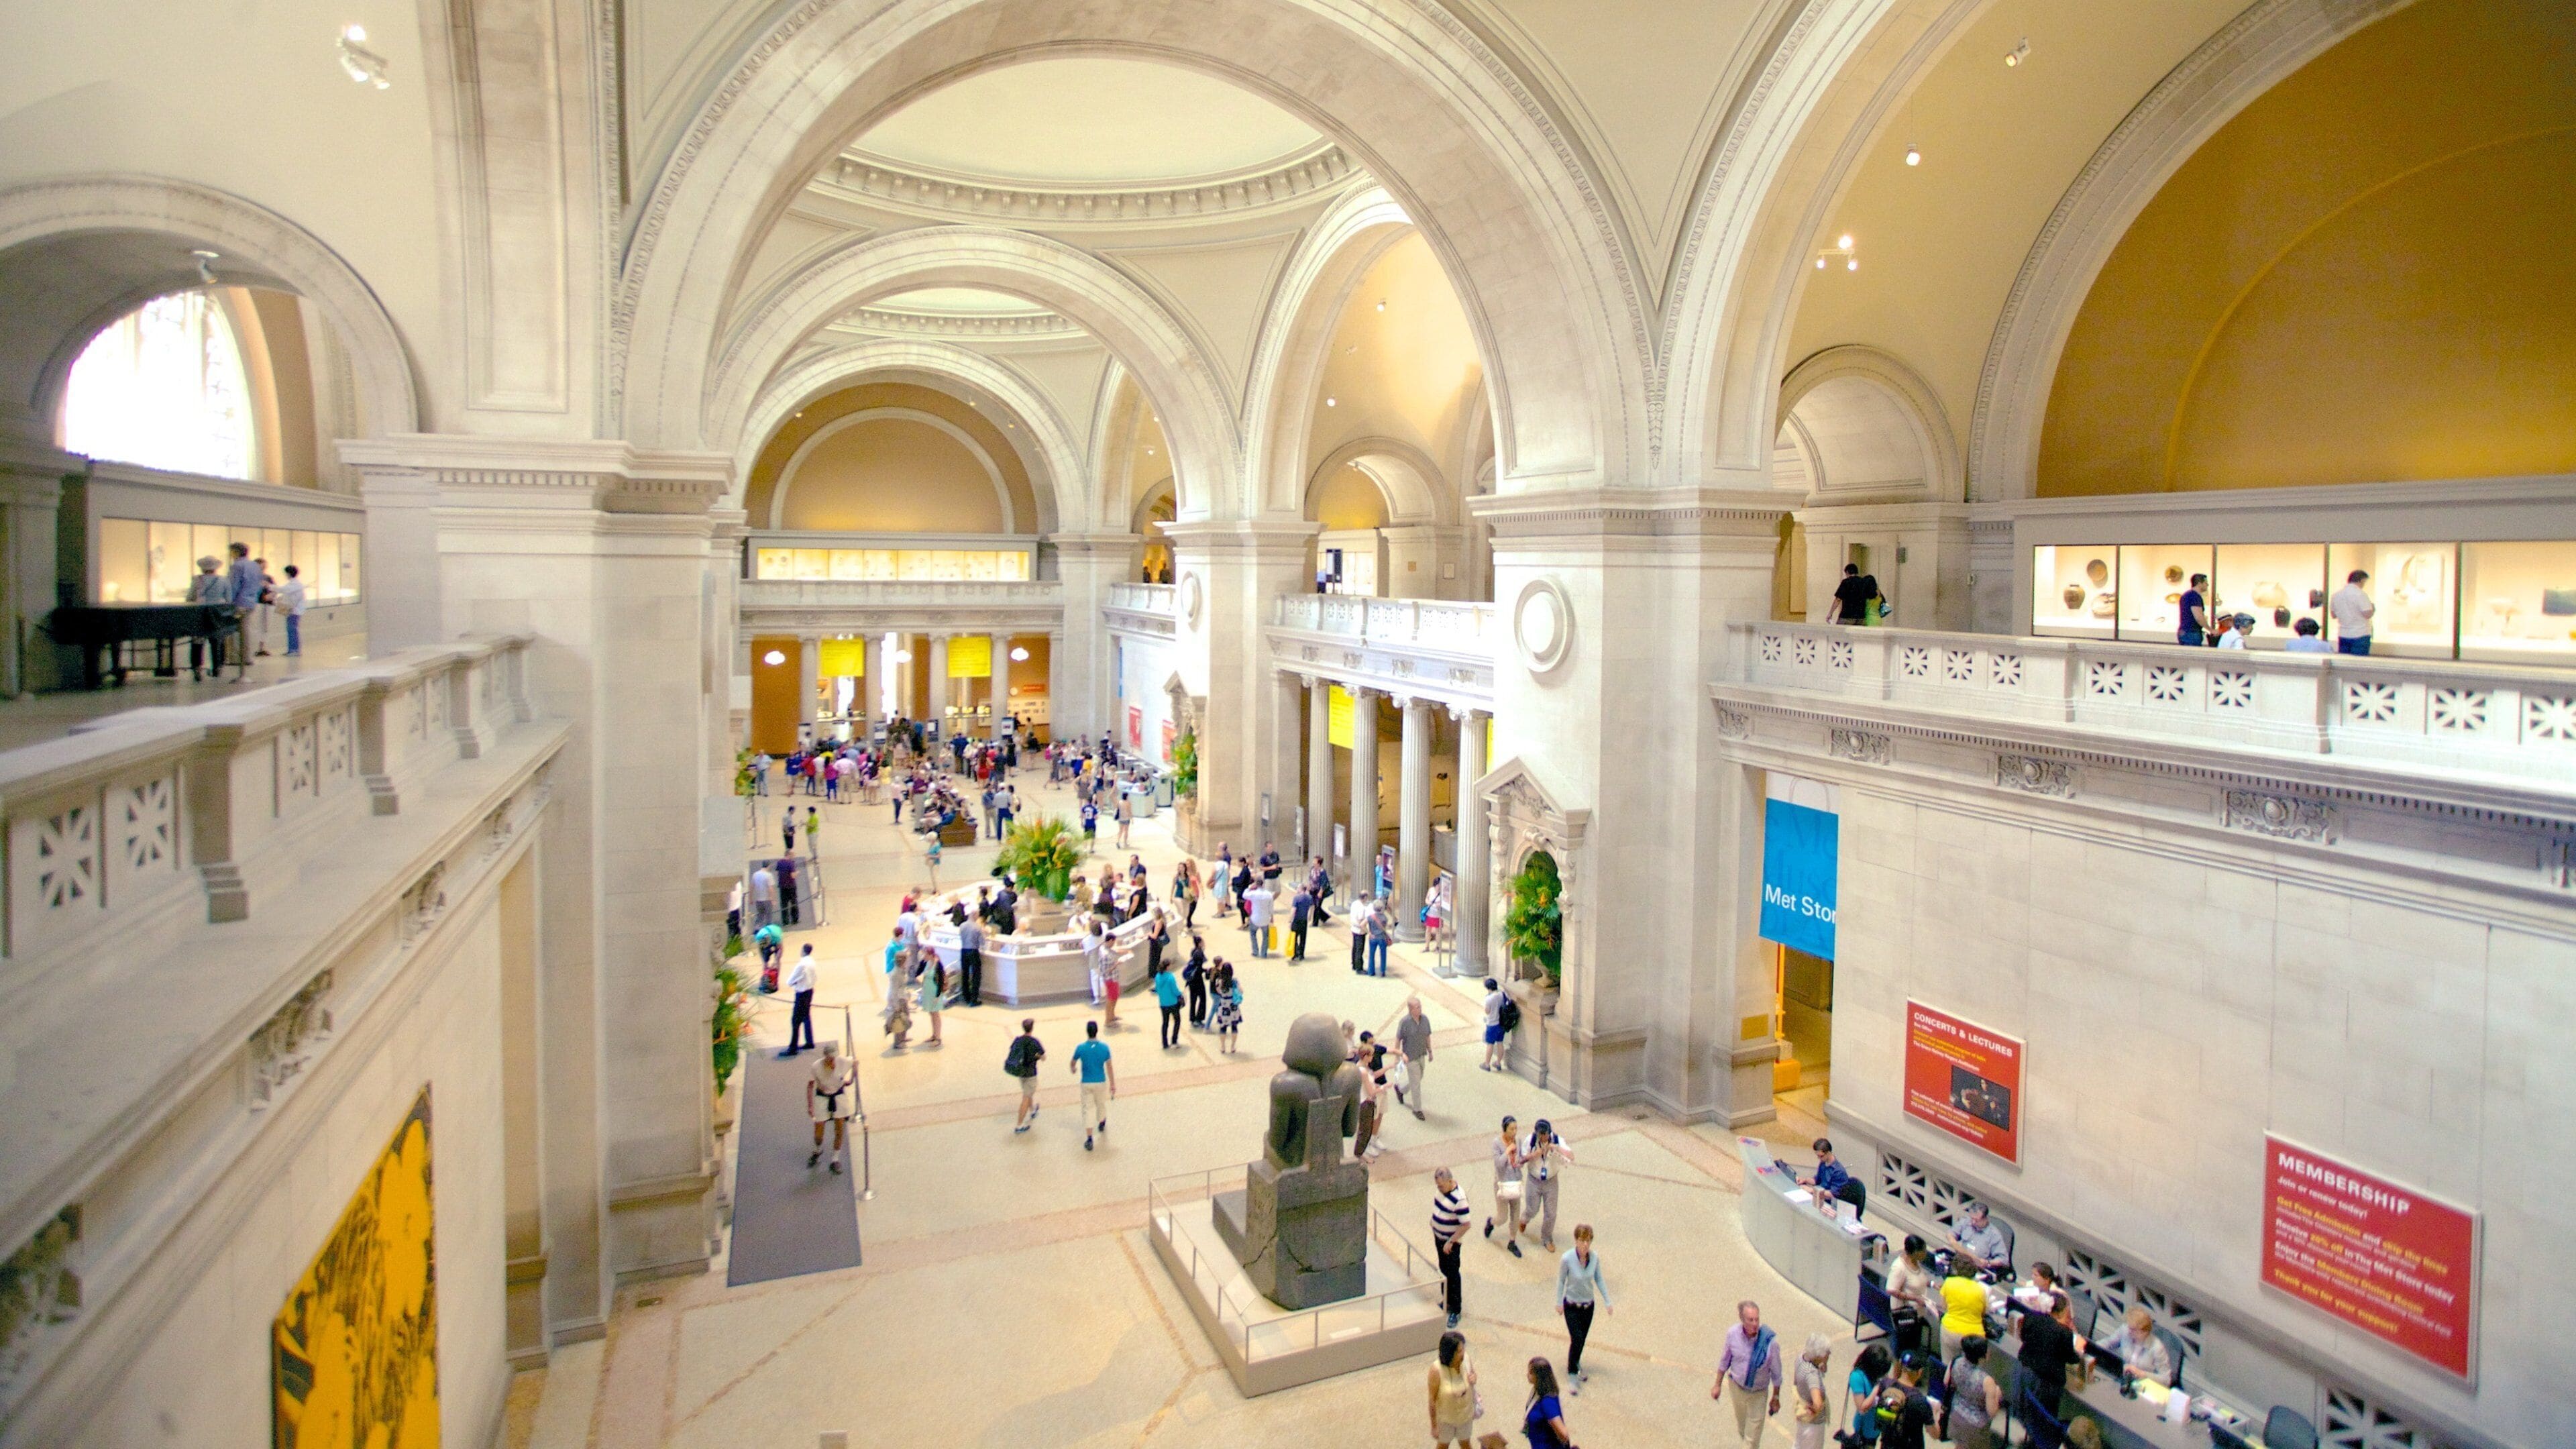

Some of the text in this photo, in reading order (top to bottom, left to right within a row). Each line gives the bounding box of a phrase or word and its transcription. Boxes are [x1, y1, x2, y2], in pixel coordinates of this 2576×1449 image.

[1765, 883, 1835, 924] Met Stor
[1915, 1012, 1955, 1034] CONCERTS
[1960, 1030, 1965, 1038] &
[1969, 1034, 2012, 1056] LECTURES
[2277, 1176, 2295, 1189] Join
[2310, 1190, 2336, 1205] renew
[2338, 1200, 2367, 1220] today!
[2279, 1152, 2410, 1214] MEMBERSHIP
[2277, 1195, 2292, 1208] Get
[2294, 1203, 2311, 1216] Free
[2314, 1211, 2359, 1237] Admission
[2363, 1232, 2381, 1246] and
[2383, 1240, 2402, 1257] skip
[2404, 1249, 2420, 1263] the
[2275, 1242, 2298, 1258] Enjoy
[2301, 1253, 2314, 1265] the
[2317, 1260, 2359, 1285] Members
[2276, 1218, 2308, 1238] Receive
[2331, 1242, 2343, 1254] off
[2356, 1253, 2371, 1267] The
[2374, 1260, 2393, 1276] Met
[2396, 1270, 2422, 1289] Store
[2424, 1283, 2455, 1305] today
[2276, 1270, 2398, 1335] Thank you for your support!
